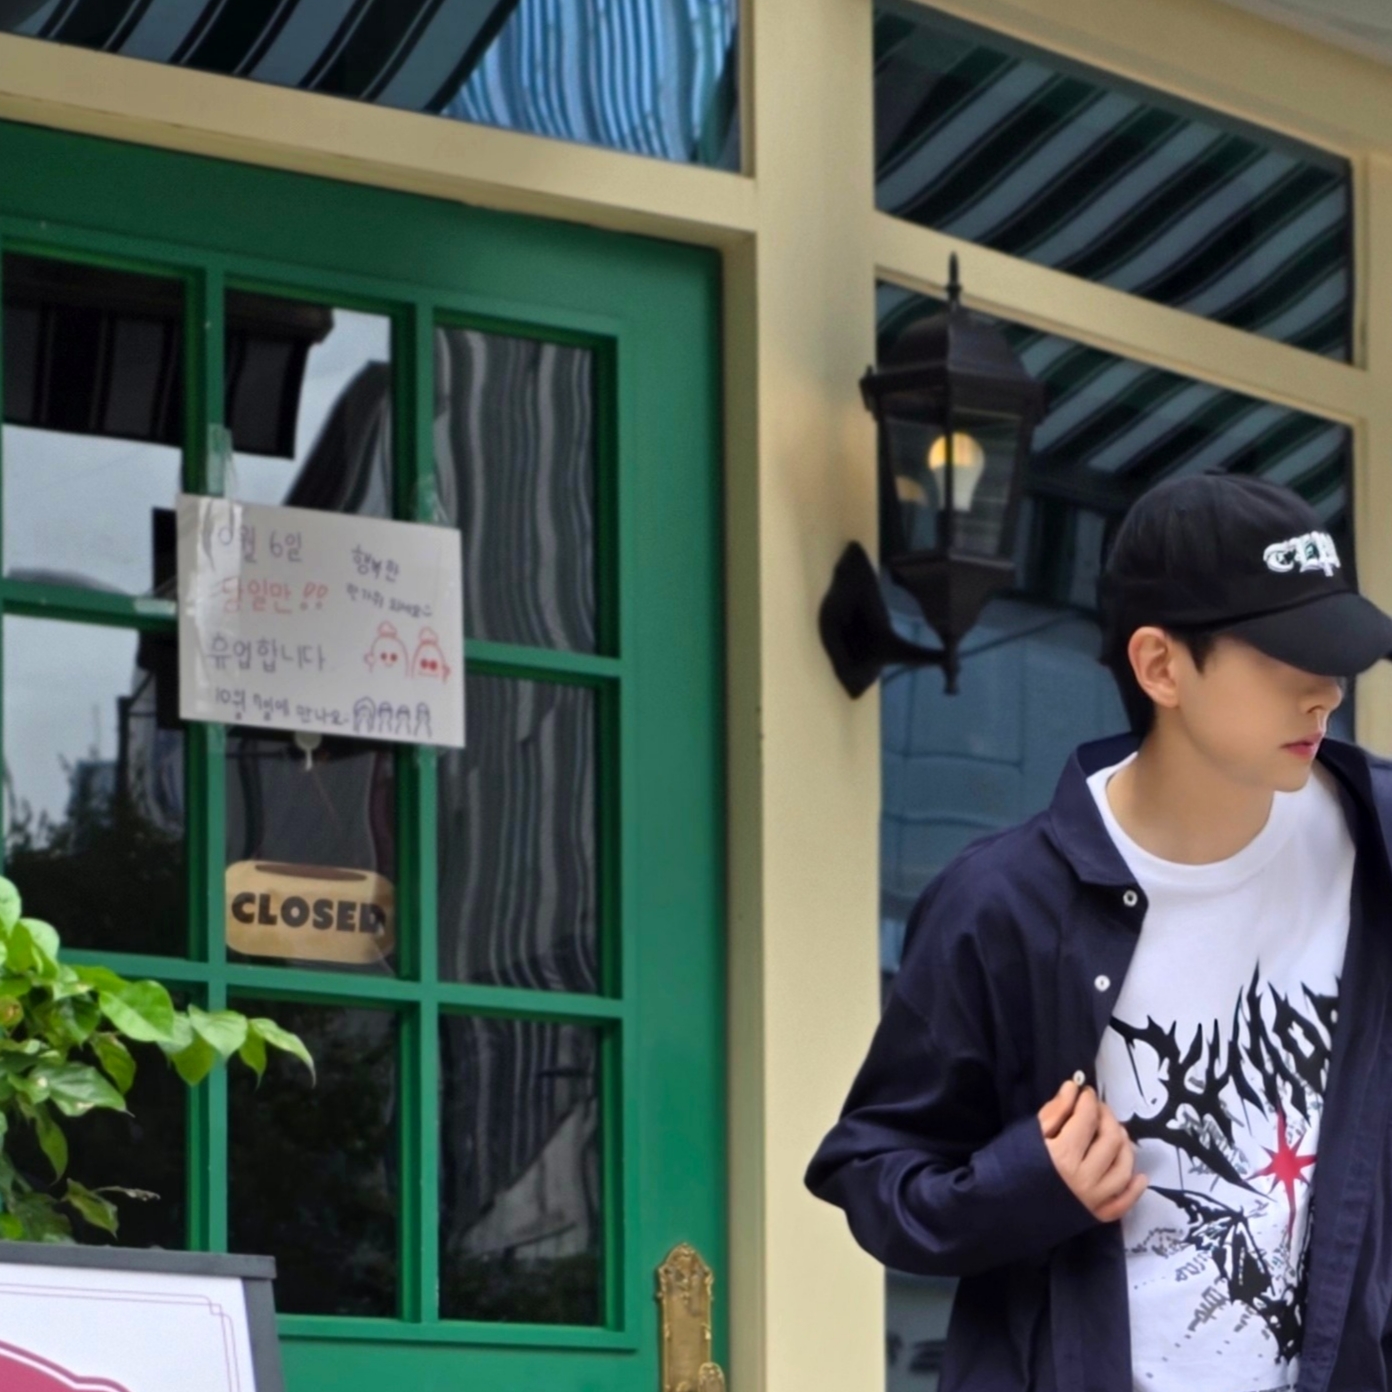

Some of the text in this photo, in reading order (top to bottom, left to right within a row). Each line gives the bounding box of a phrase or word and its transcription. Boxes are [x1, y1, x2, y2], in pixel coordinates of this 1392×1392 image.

[269, 530, 302, 563] 6일
[221, 576, 293, 614] 당일만
[206, 631, 326, 673] 휴업합니다
[215, 687, 246, 721] 10월
[231, 891, 386, 933] CLOSED
